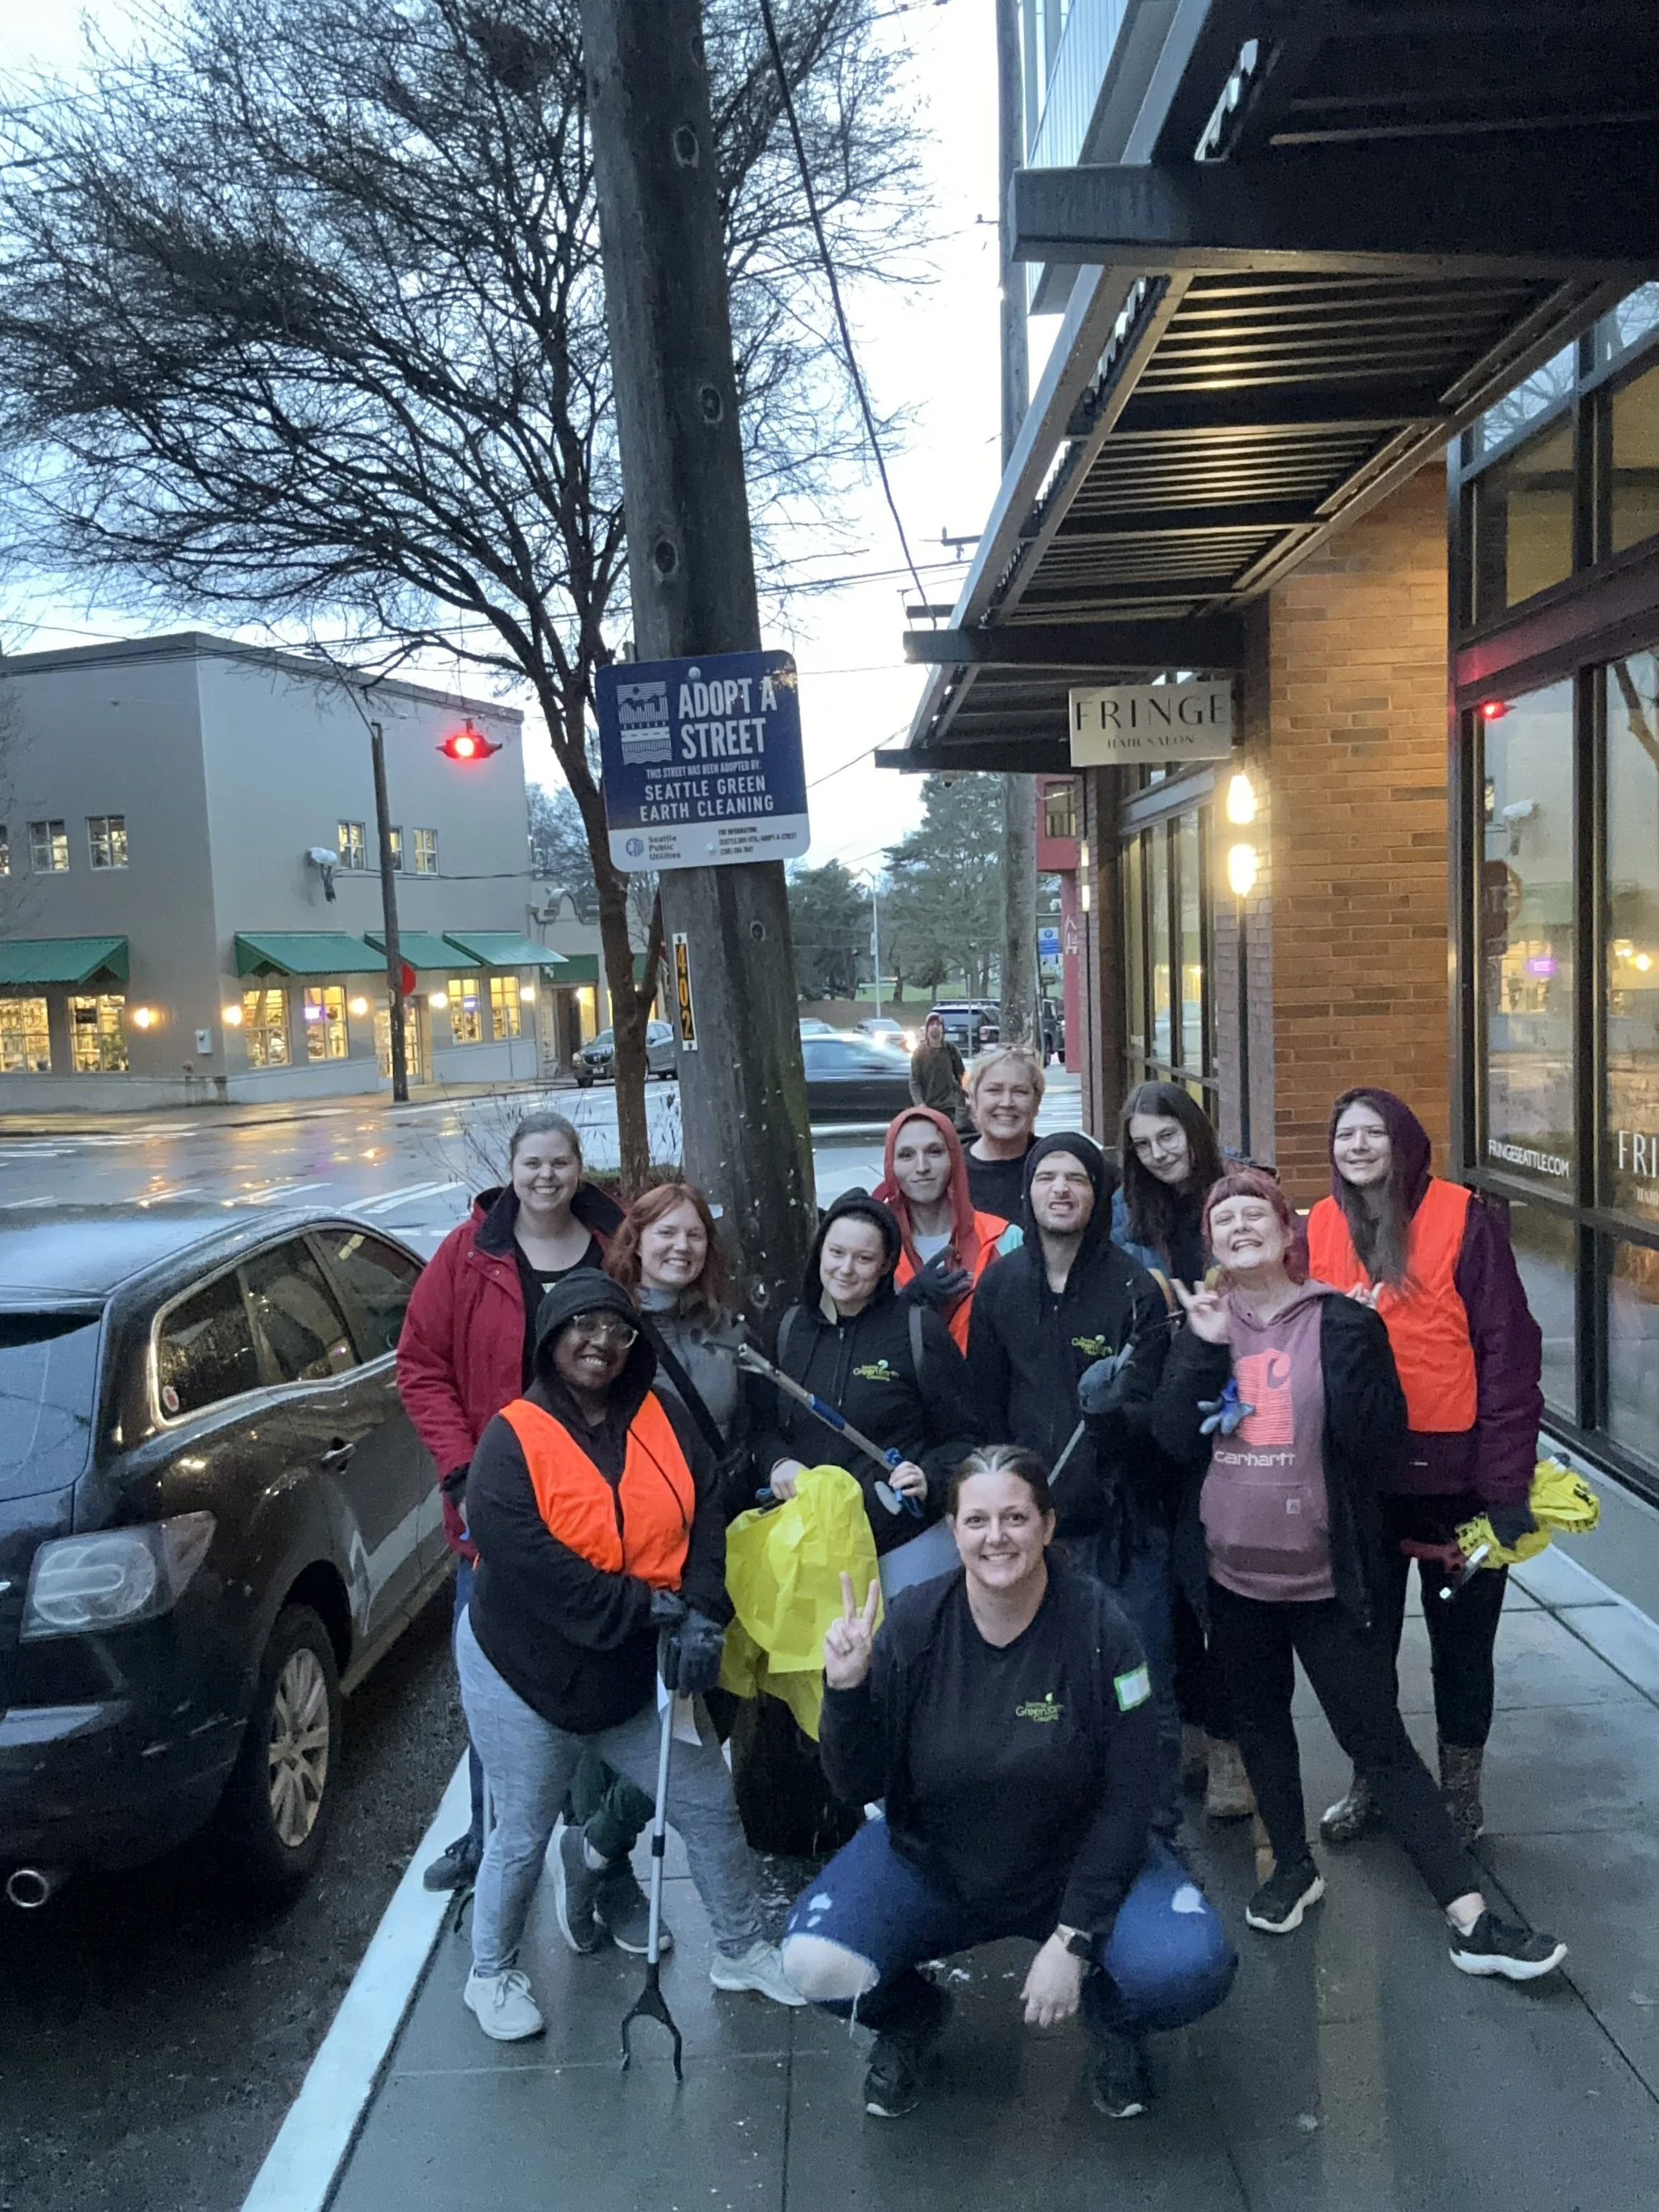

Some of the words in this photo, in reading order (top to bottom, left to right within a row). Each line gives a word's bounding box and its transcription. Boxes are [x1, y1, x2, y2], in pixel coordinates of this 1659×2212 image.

[678, 678, 753, 719] ADOPT
[761, 676, 778, 712] A
[1076, 693, 1228, 731] FRINGE
[681, 718, 766, 759] STREET
[1107, 737, 1141, 749] HAIR
[1146, 734, 1196, 746] SALON
[646, 769, 662, 779] THIS
[663, 766, 686, 778] STREET
[688, 764, 701, 776] HAS
[702, 763, 719, 775] BEEN
[720, 761, 750, 774] ADOPTED
[645, 780, 709, 802] SEATTLE
[717, 775, 766, 795] GREEN
[640, 802, 690, 822] EARTH
[698, 794, 774, 817] CLEANING
[648, 835, 677, 843] Seattle
[649, 852, 681, 860] Utilities
[678, 944, 693, 1039] 402
[1214, 1451, 1295, 1467] carhartt
